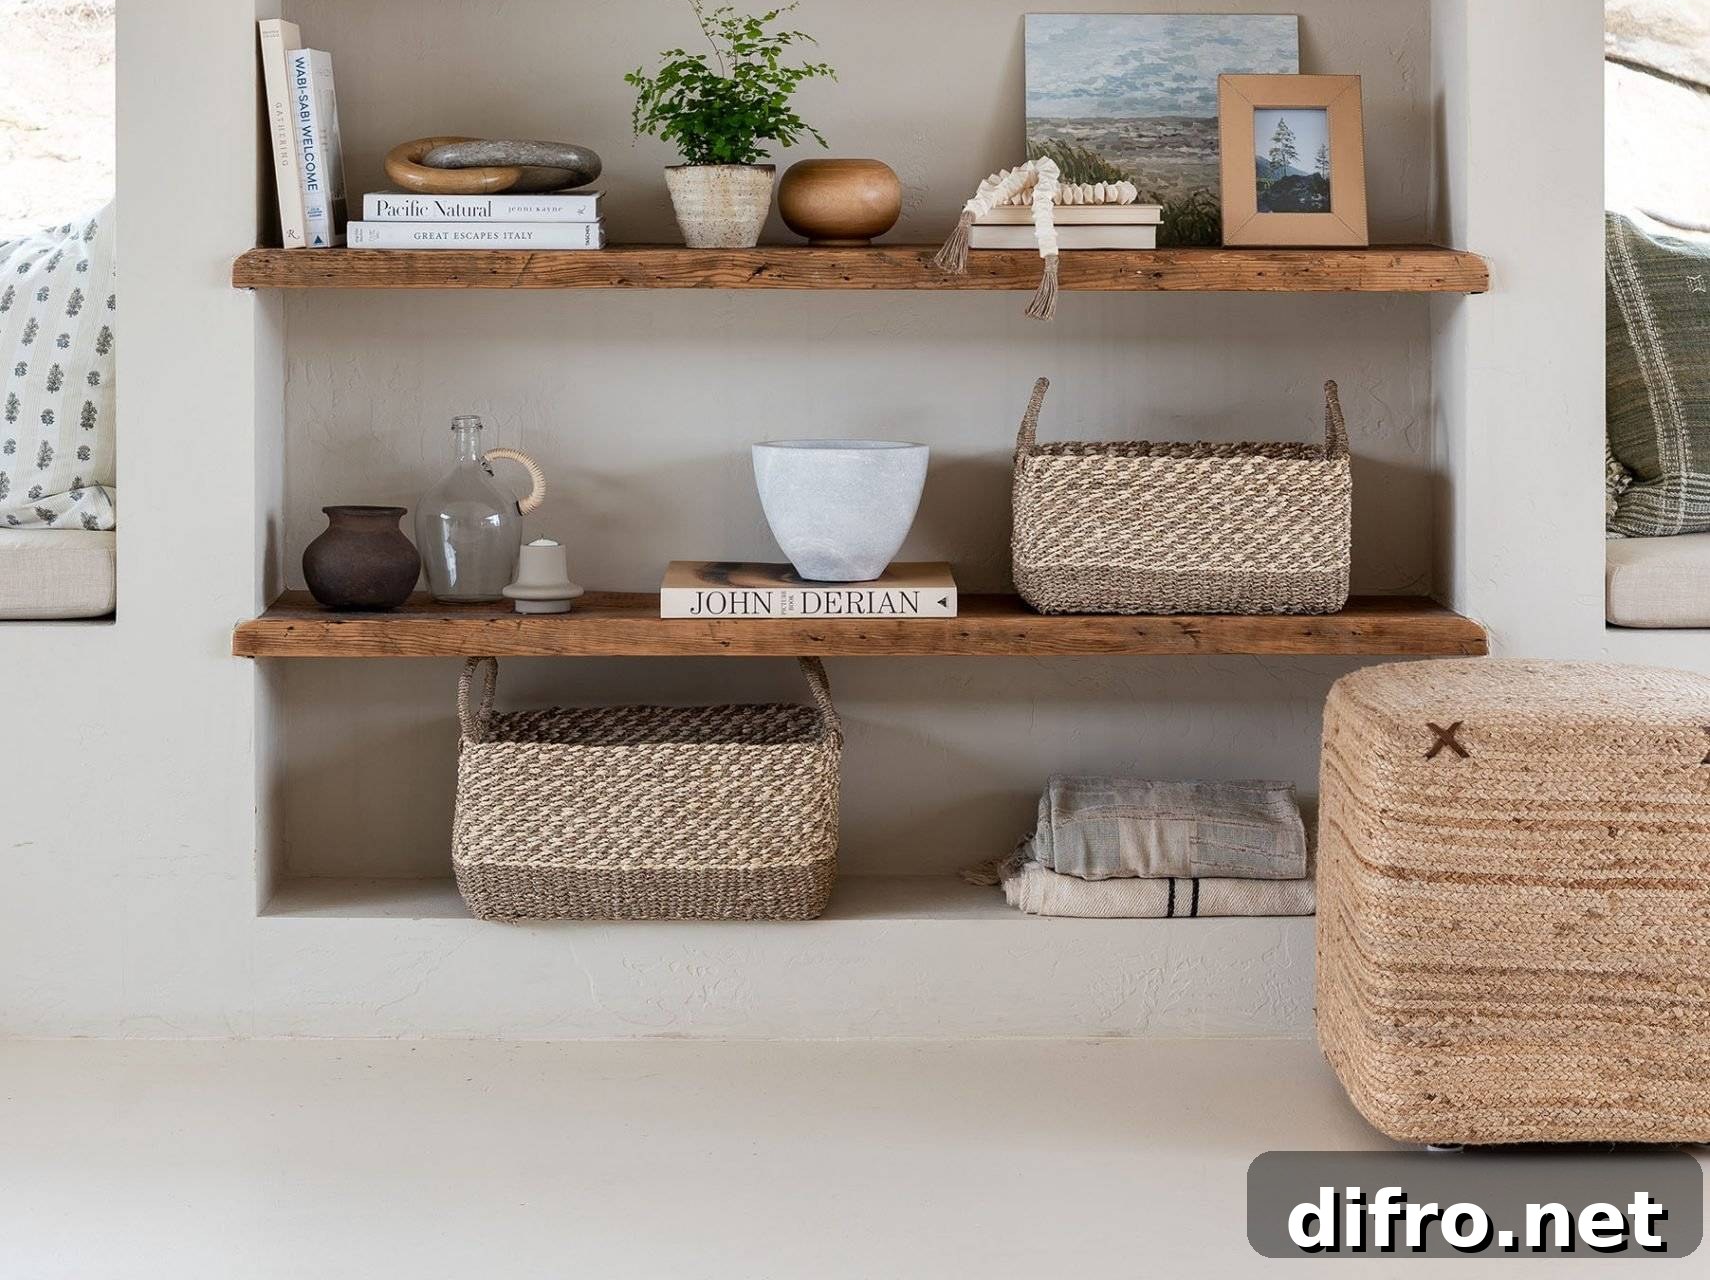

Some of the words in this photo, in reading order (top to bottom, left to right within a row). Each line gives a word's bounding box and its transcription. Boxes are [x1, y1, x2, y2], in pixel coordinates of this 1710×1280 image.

[295, 56, 311, 122] WABI-SABI
[302, 124, 319, 191] WELCOME
[376, 199, 429, 218] Pacific
[434, 199, 492, 218] Natural
[413, 231, 449, 241] GREAT
[453, 231, 499, 241] ESCAPES
[503, 231, 534, 241] ITALY
[690, 590, 772, 615] JOHN
[801, 590, 920, 615] DERIAN
